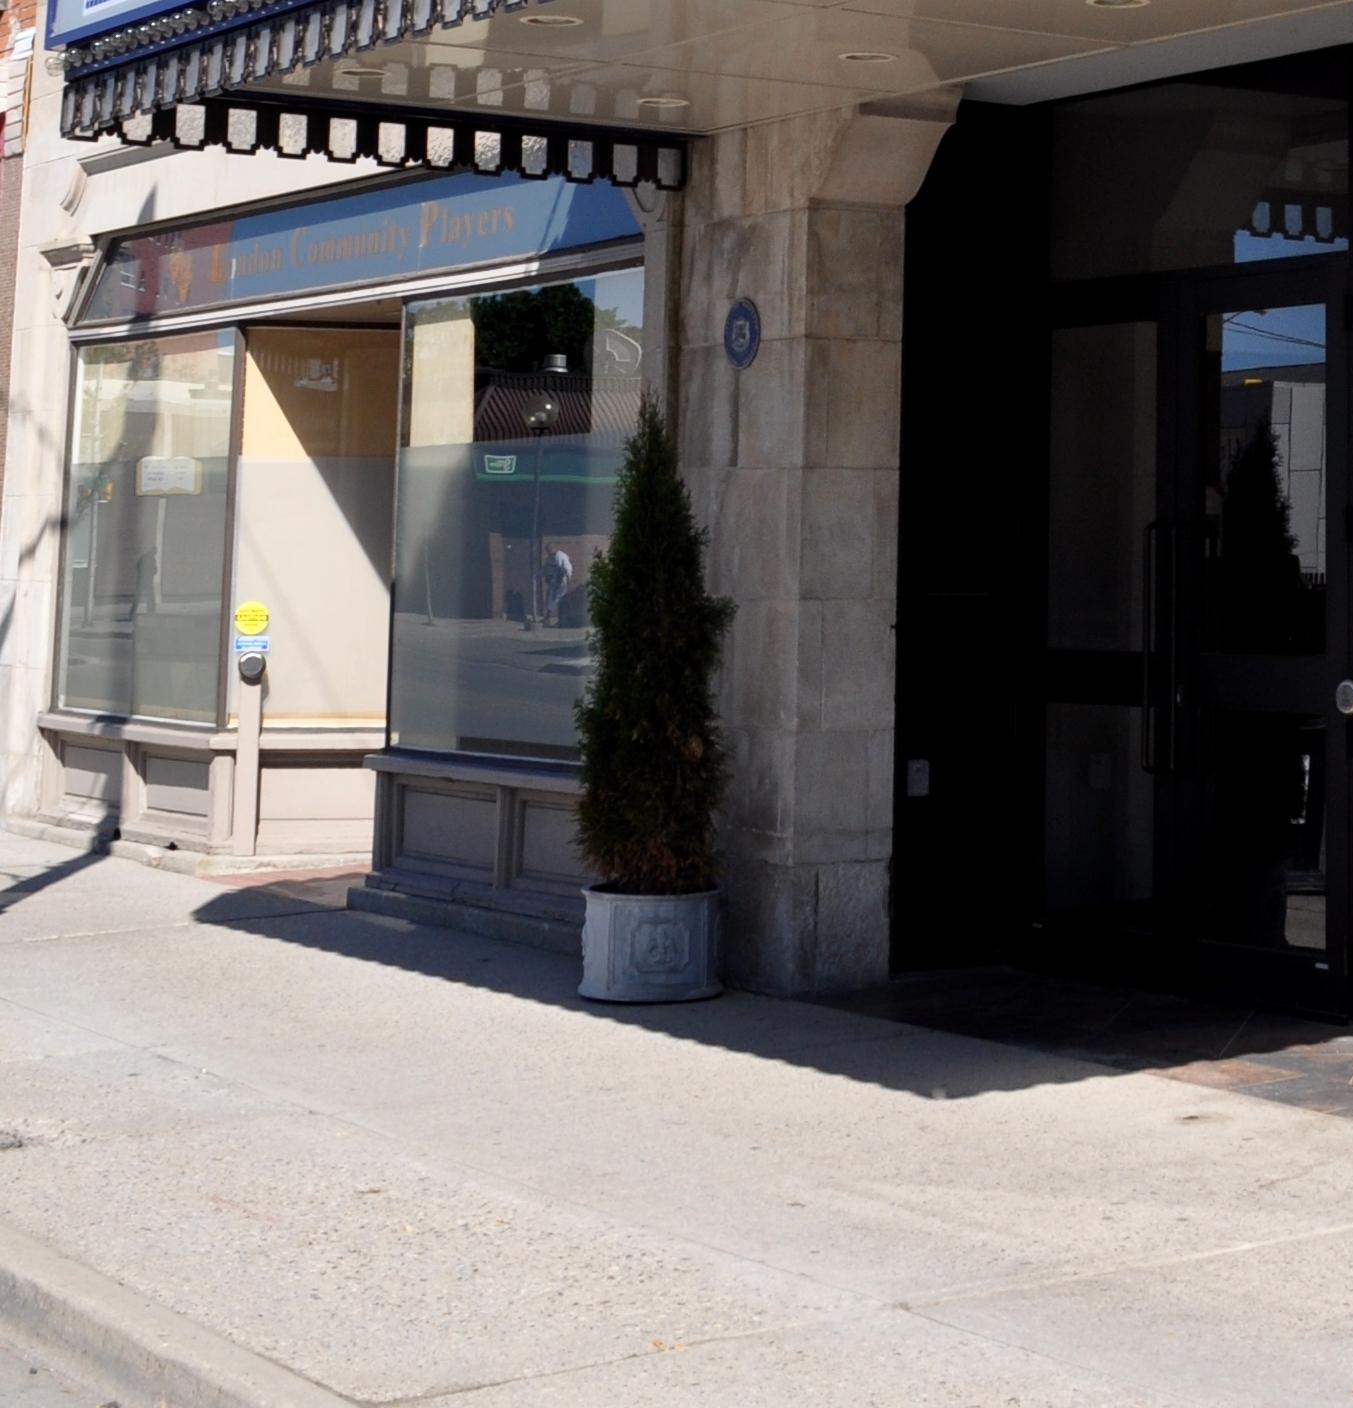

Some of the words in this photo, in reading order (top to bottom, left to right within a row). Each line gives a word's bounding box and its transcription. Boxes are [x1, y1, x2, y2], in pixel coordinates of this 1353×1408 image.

[211, 243, 283, 285] London
[290, 216, 411, 268] Community
[421, 201, 515, 249] Players
